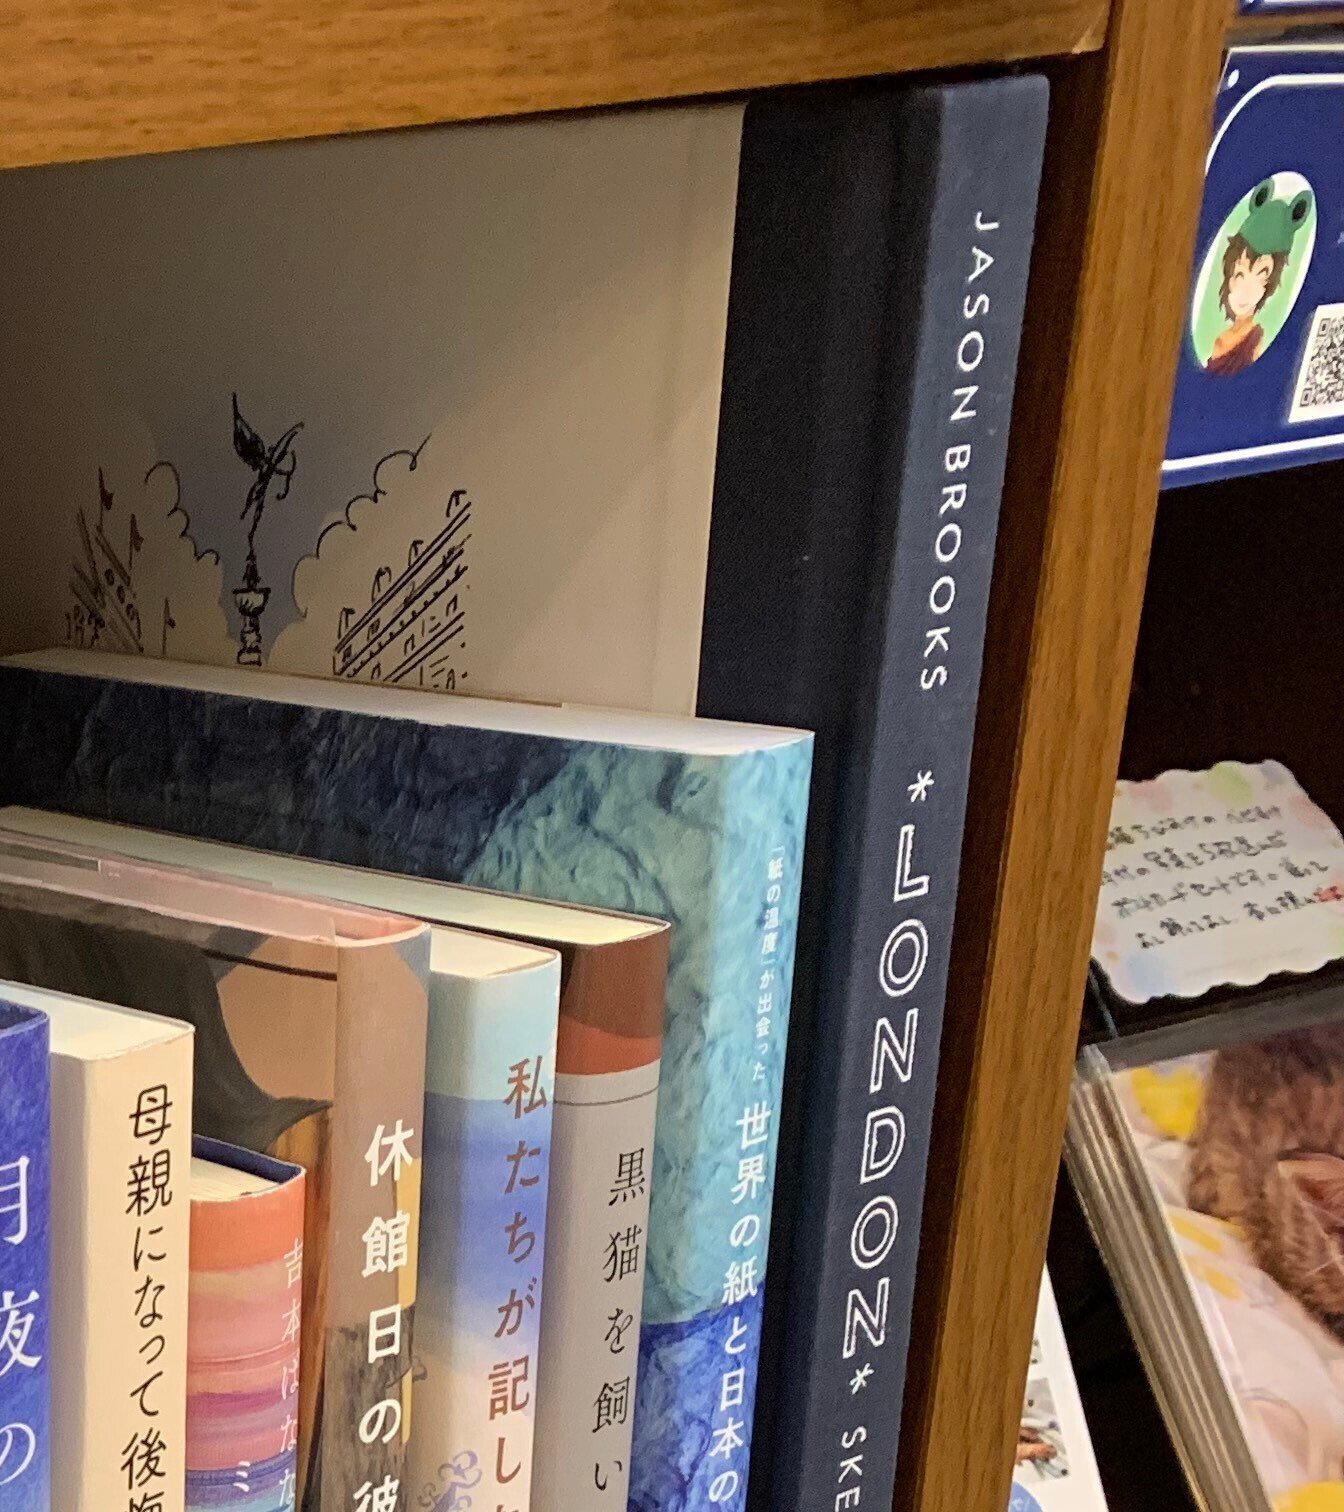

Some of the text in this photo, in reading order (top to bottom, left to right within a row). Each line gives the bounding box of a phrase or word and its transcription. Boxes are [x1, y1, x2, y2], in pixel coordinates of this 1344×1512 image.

[920, 211, 1000, 691] JASON BROOKS
[842, 822, 930, 1359] LONDON
